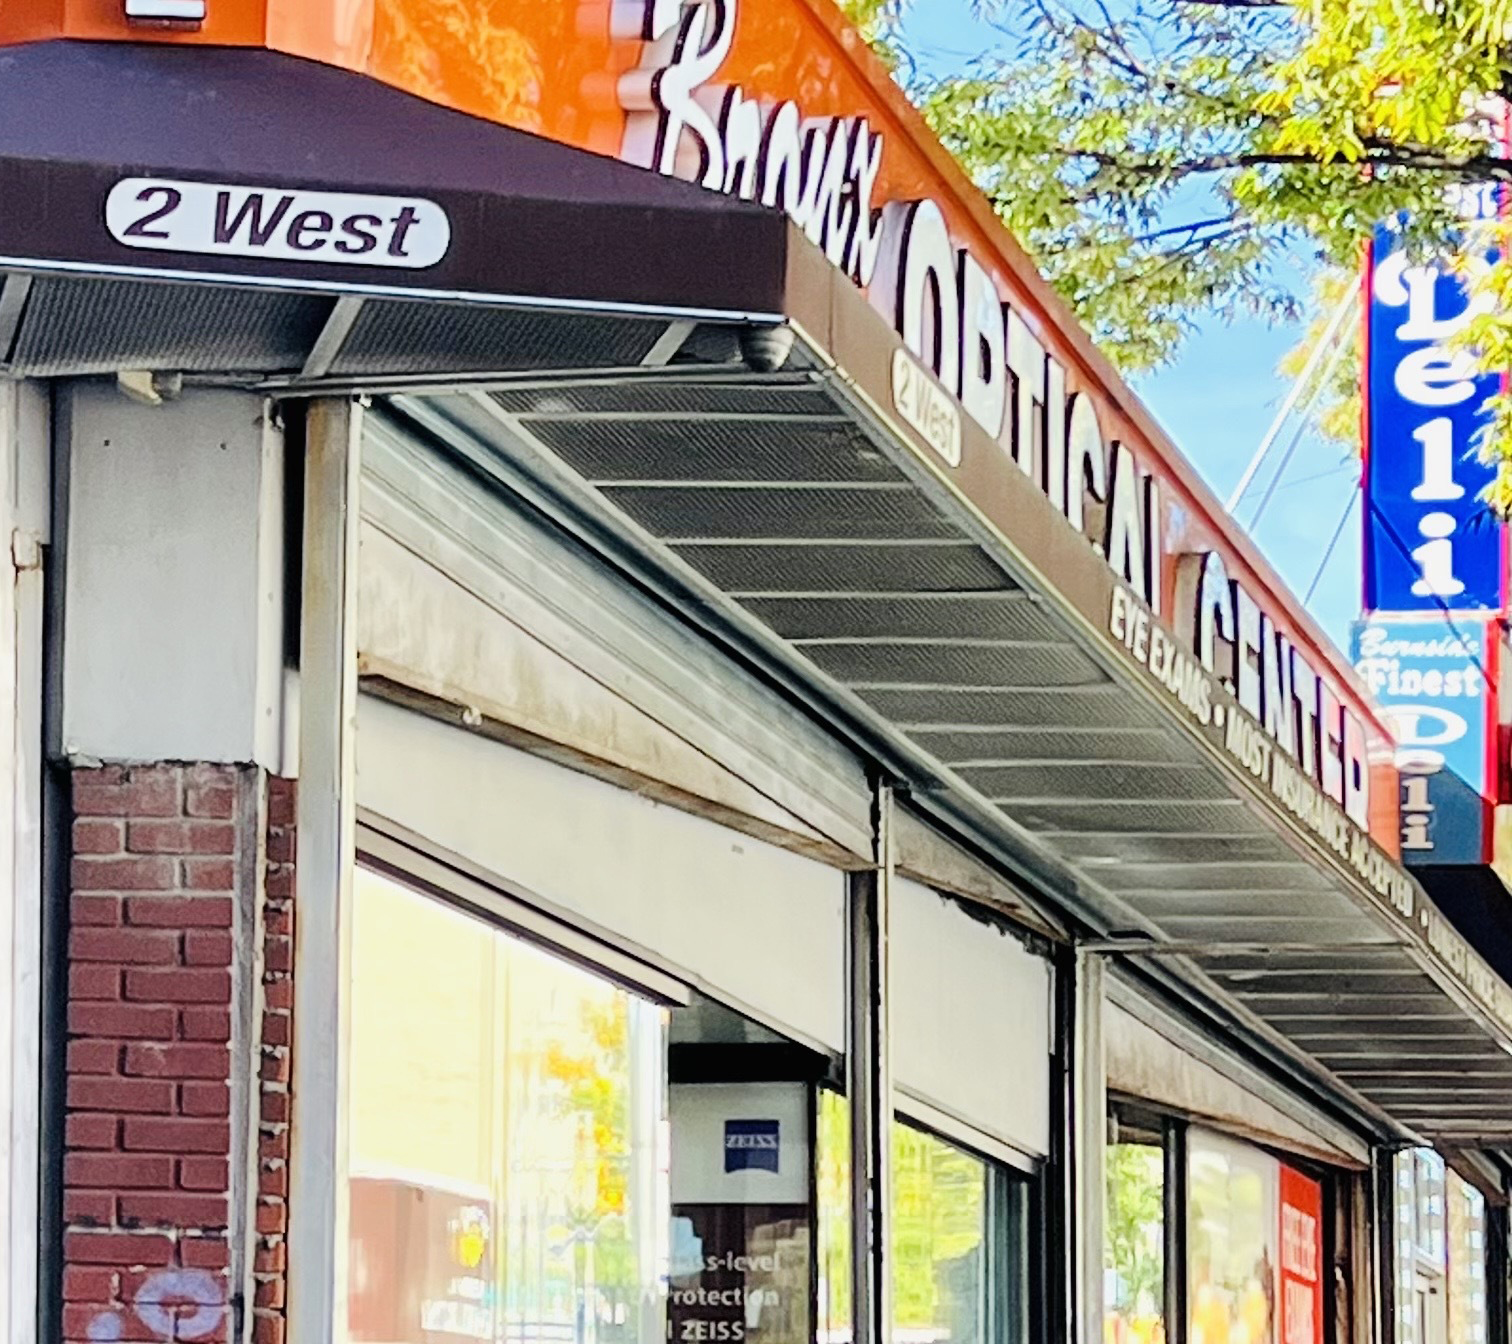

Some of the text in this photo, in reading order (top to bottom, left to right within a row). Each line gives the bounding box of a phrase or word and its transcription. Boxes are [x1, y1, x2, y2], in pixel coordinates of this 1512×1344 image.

[122, 186, 421, 258] 2 West
[894, 366, 958, 460] 2 West
[1374, 253, 1497, 598] Deli
[1110, 585, 1150, 664] EYE
[1149, 622, 1212, 726] EXAMS
[1226, 706, 1272, 784] MOST
[1355, 657, 1482, 698] Finest
[725, 1133, 778, 1149] ZEISS
[668, 1285, 780, 1307] rotection
[680, 1320, 745, 1341] ZEISS
